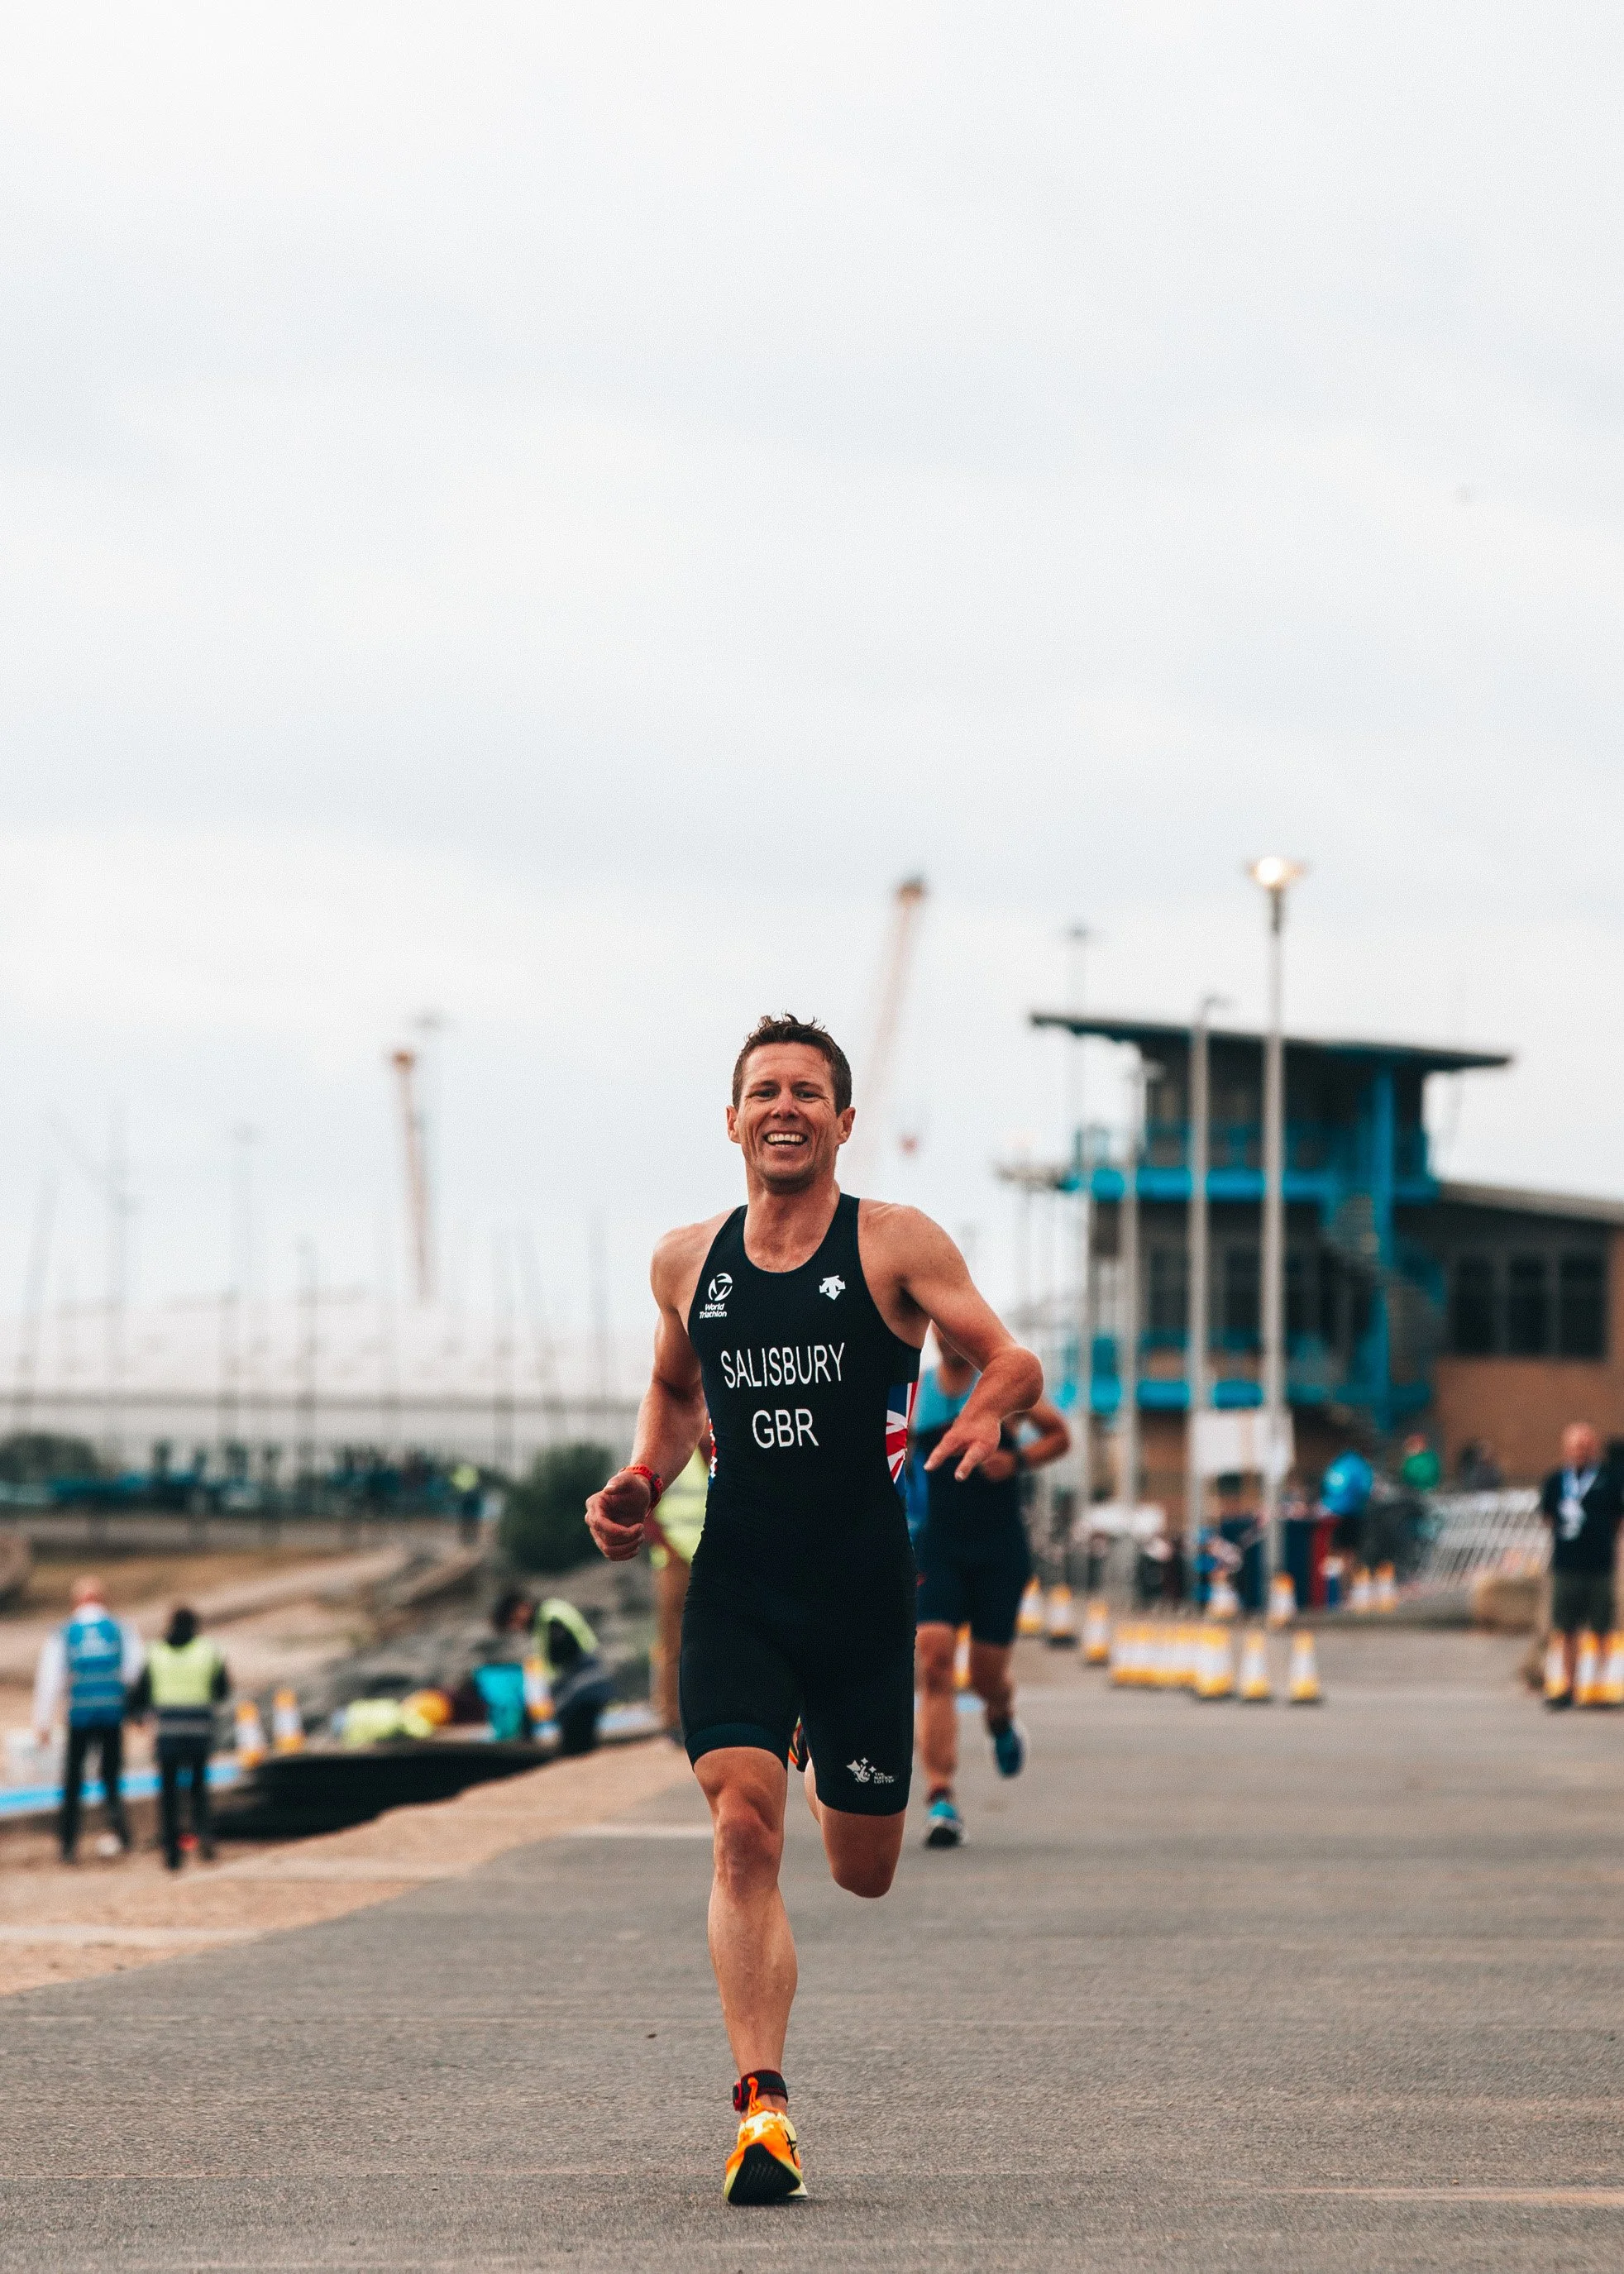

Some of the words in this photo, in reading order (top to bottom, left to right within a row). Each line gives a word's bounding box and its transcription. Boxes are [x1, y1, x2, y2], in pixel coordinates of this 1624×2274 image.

[700, 1311, 728, 1319] Triathlon
[720, 1342, 845, 1388] SALISBURY
[752, 1408, 819, 1449] GBR
